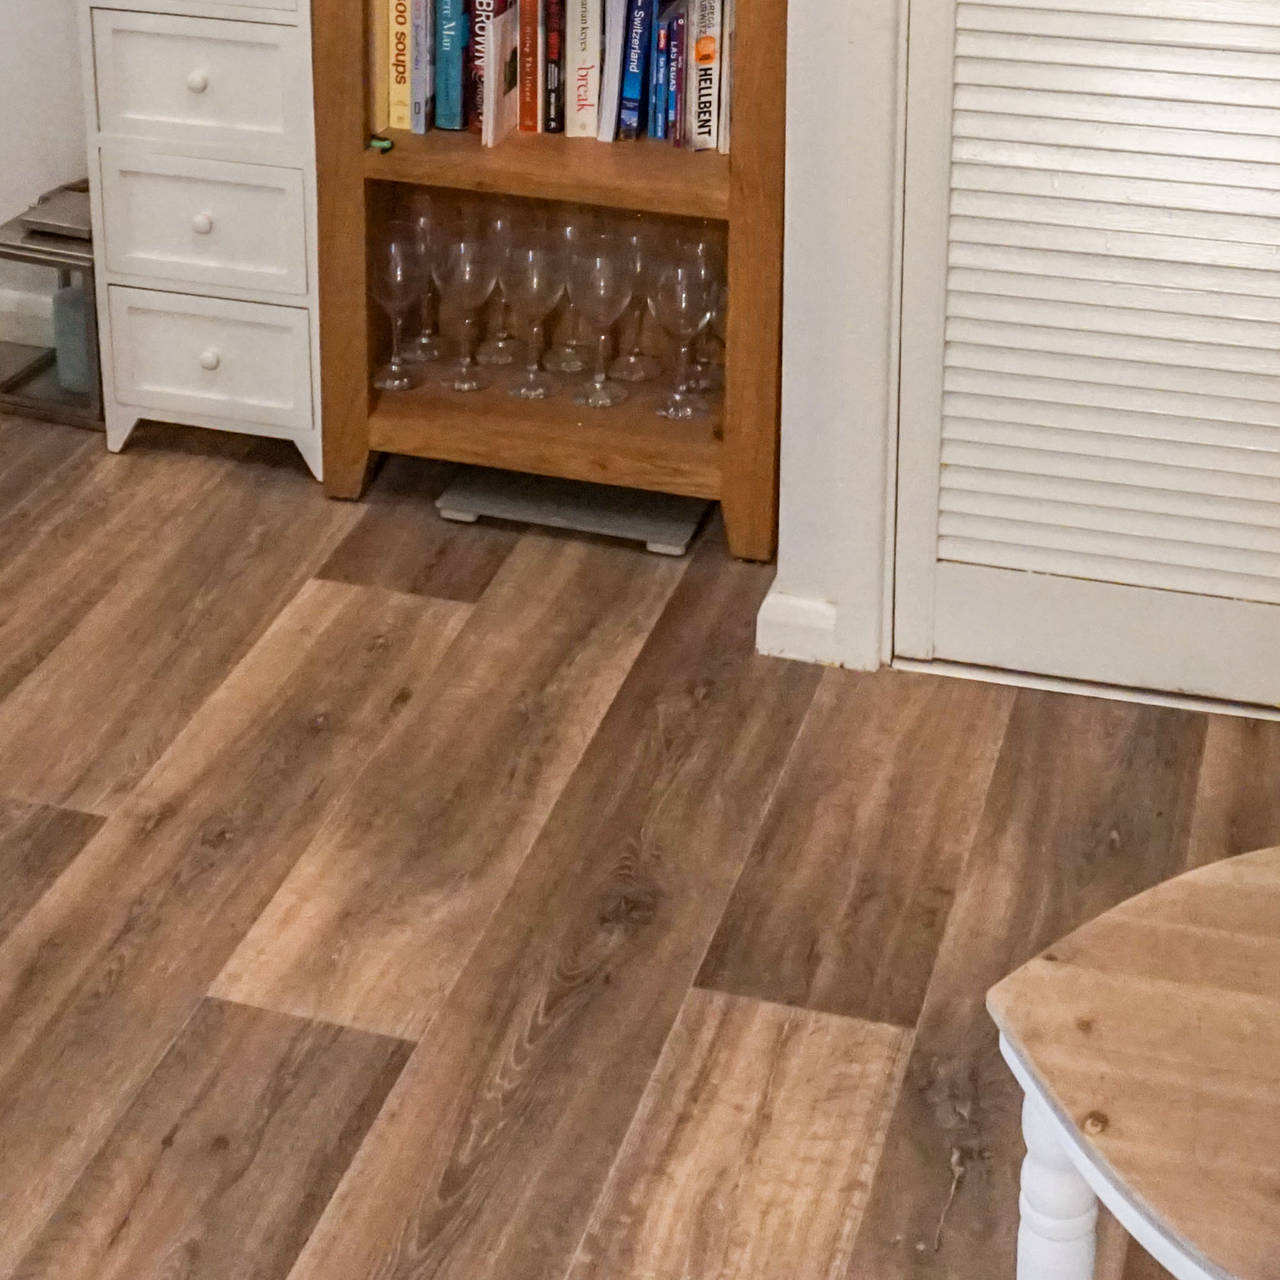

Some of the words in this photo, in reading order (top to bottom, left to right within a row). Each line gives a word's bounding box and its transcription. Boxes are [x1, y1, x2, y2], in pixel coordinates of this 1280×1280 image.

[442, 21, 455, 51] Man
[629, 9, 645, 73] Switzerland
[670, 41, 678, 59] LAS
[576, 64, 595, 113] break
[669, 61, 677, 91] VEGAS
[697, 67, 713, 136] HELLBENT
